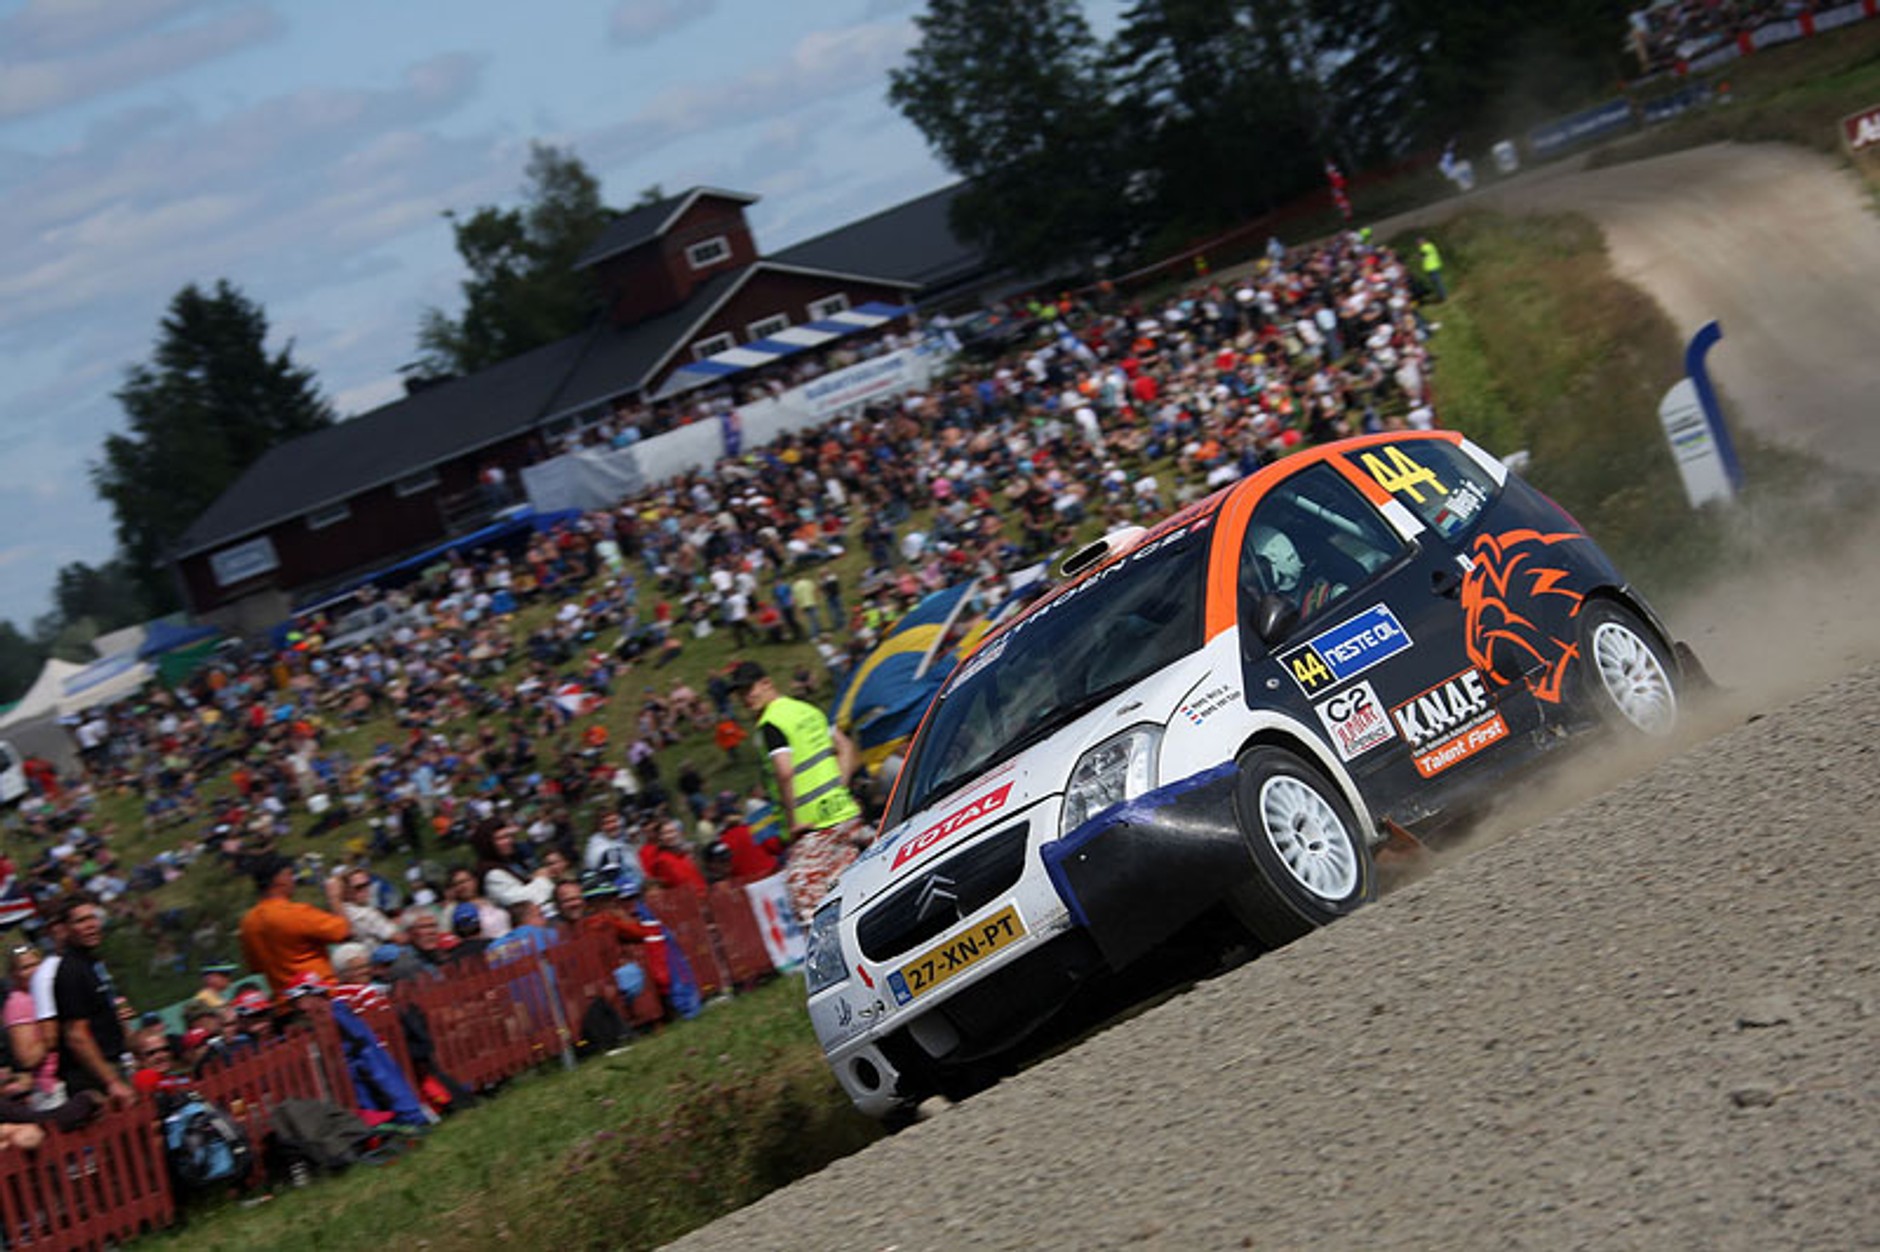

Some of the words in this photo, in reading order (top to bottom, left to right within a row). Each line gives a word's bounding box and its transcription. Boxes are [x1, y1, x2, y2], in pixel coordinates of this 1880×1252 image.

[1360, 445, 1449, 503] 44
[1292, 652, 1330, 687] 44
[1373, 621, 1400, 641] OIL
[1327, 688, 1372, 722] C2
[1394, 669, 1487, 746] KNAF
[1421, 740, 1468, 772] Talent
[1468, 719, 1503, 749] First
[904, 796, 1002, 857] TOTAL
[909, 914, 1014, 990] 27-XN-PT
